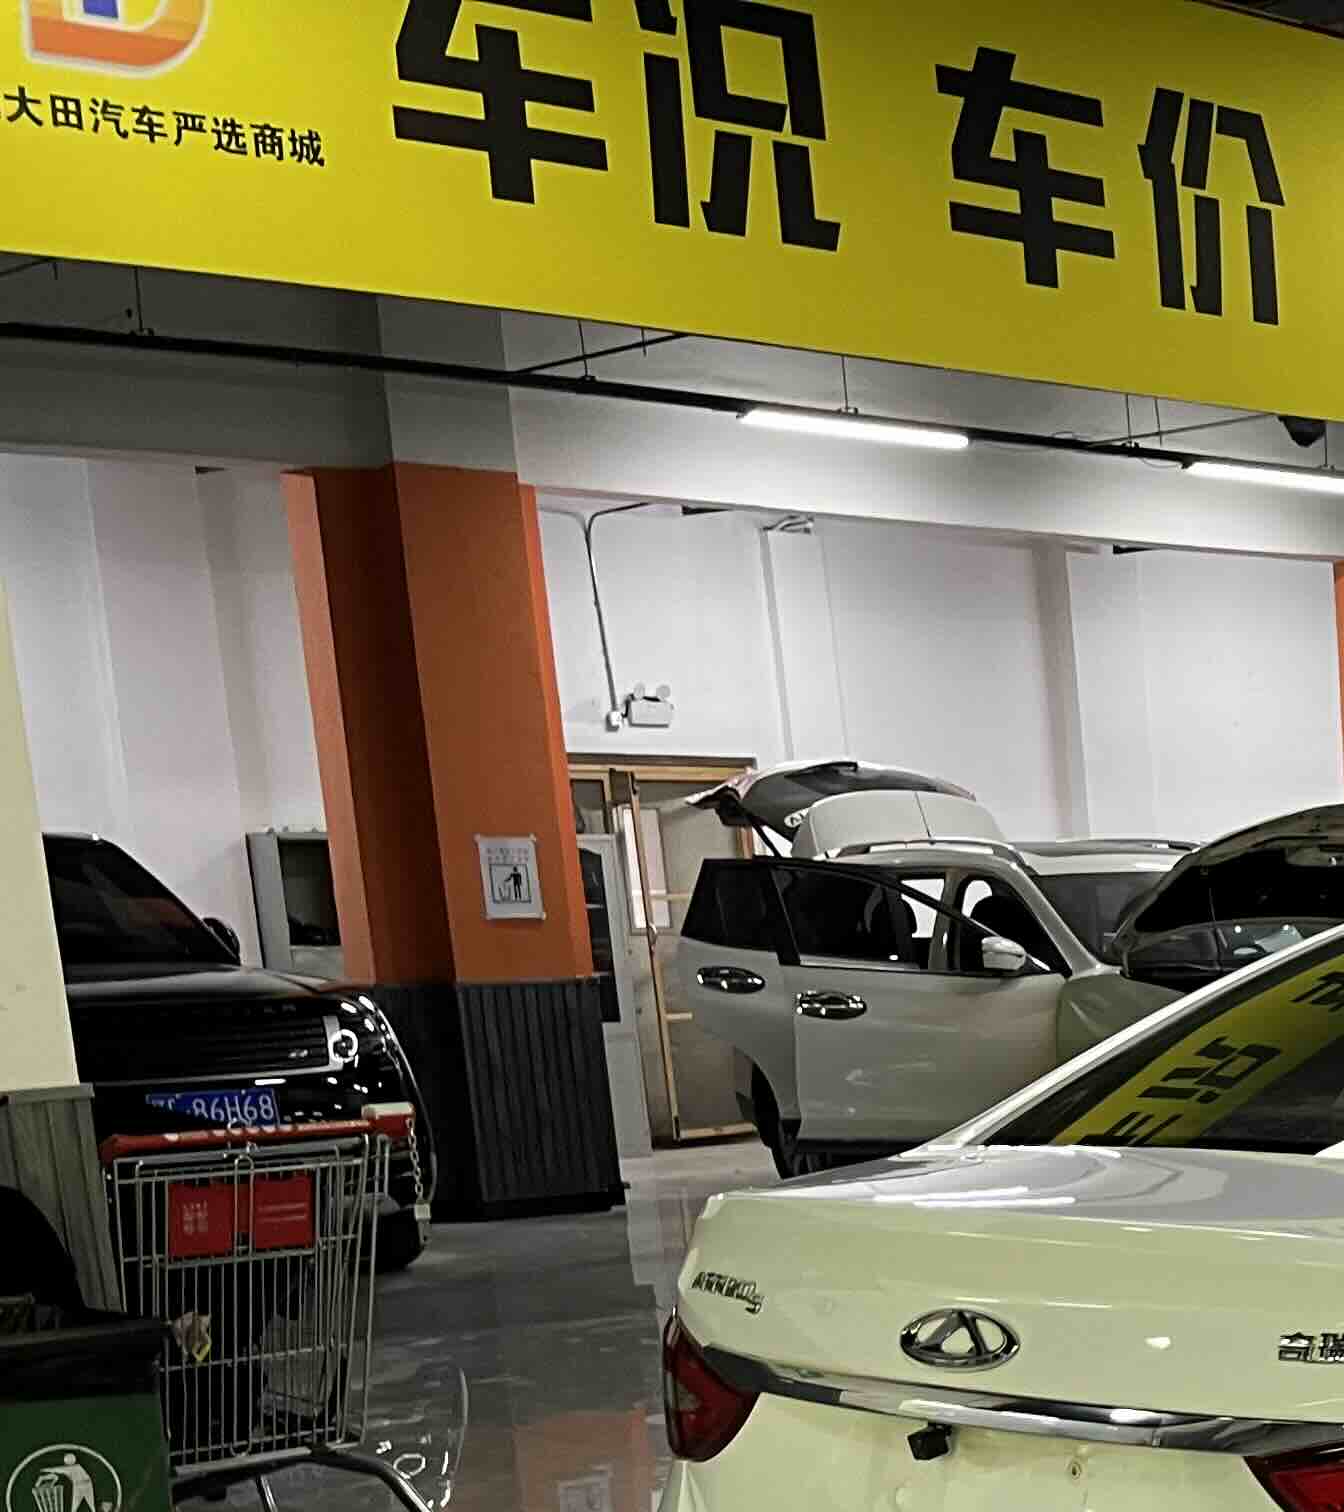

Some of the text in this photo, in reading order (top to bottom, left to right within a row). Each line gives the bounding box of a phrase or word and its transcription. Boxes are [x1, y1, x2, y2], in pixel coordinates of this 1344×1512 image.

[3, 85, 325, 167] 大田汽车严选商城
[392, 0, 841, 253] 车况
[936, 45, 1286, 326] 车价
